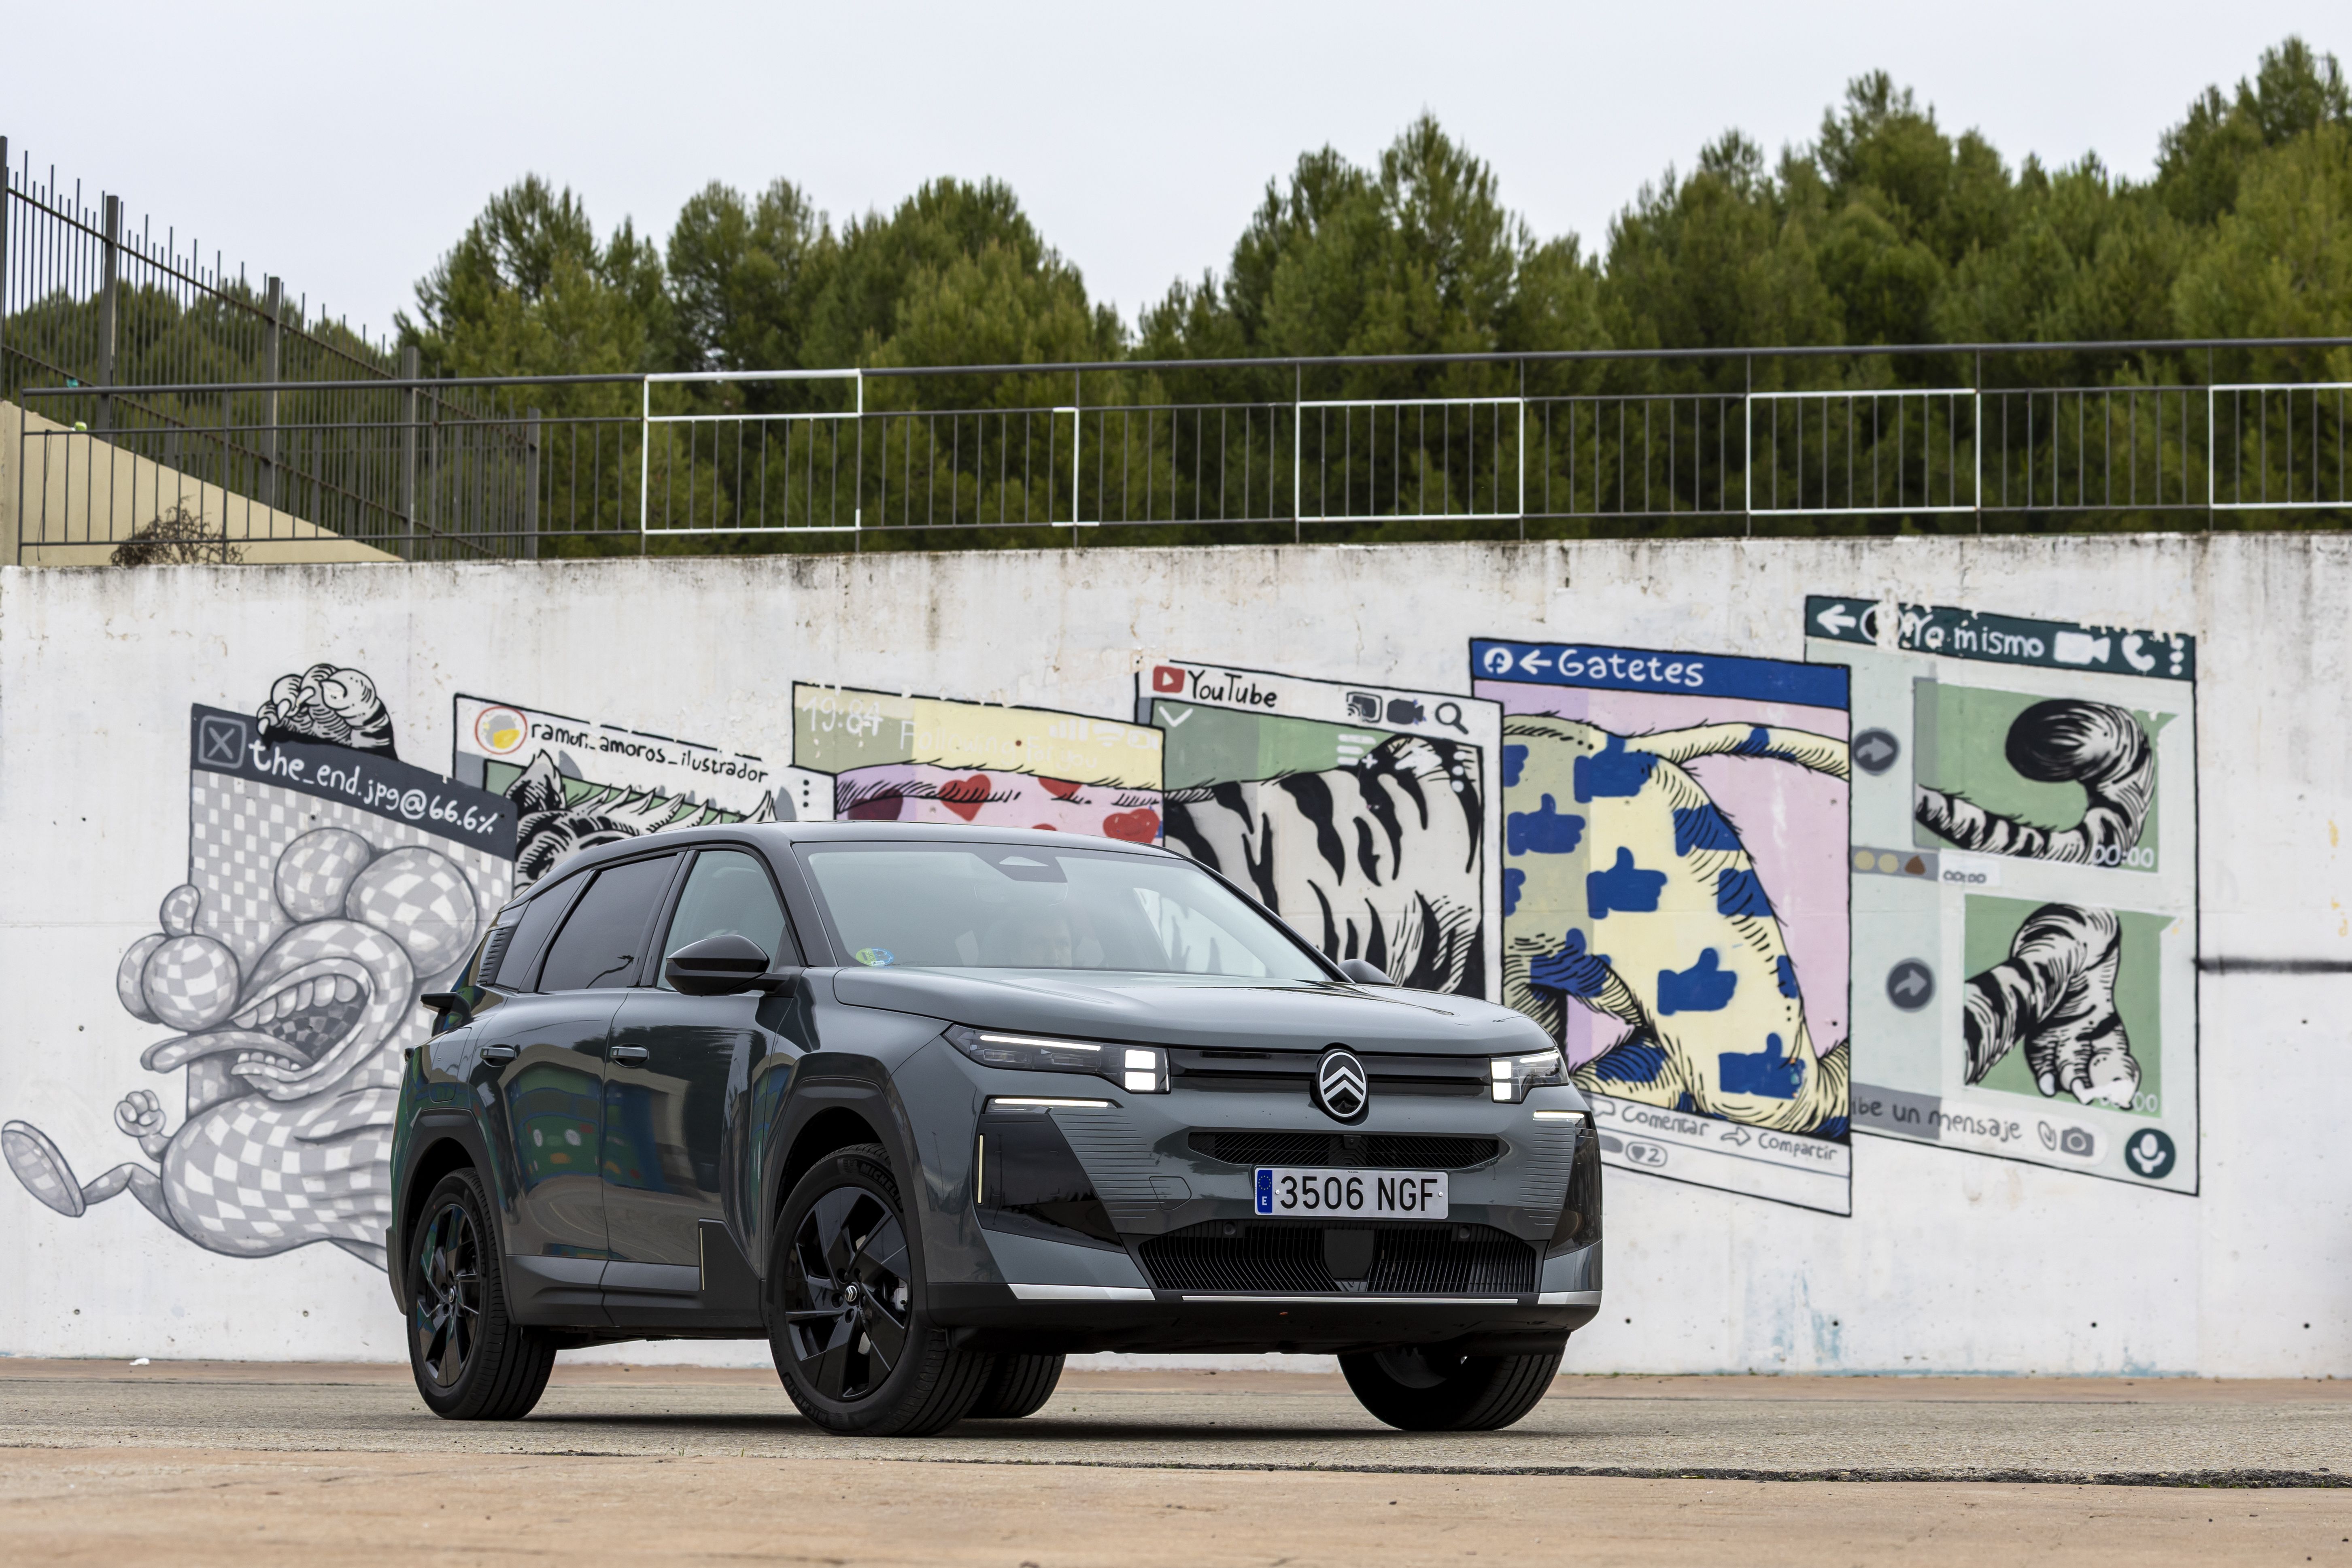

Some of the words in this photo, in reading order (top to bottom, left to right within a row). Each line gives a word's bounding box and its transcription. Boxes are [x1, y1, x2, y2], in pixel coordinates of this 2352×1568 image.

[1954, 627, 2044, 658] mismo
[1558, 649, 1704, 687] Gatetes
[1188, 670, 1277, 708] YouTube
[802, 696, 884, 737] 19:84
[900, 720, 1015, 766] Following
[2092, 844, 2154, 868] 00:00
[1621, 1105, 1710, 1136] Comentar
[1758, 1133, 1837, 1160] Compartir
[1892, 1104, 1920, 1124] un
[1928, 1109, 2023, 1142] mensaje
[1648, 1148, 1660, 1162] 2
[1262, 1196, 1267, 1206] E
[1280, 1175, 1364, 1210] 3506
[1377, 1177, 1438, 1211] NGF
[784, 1375, 828, 1423] MICHELIN
